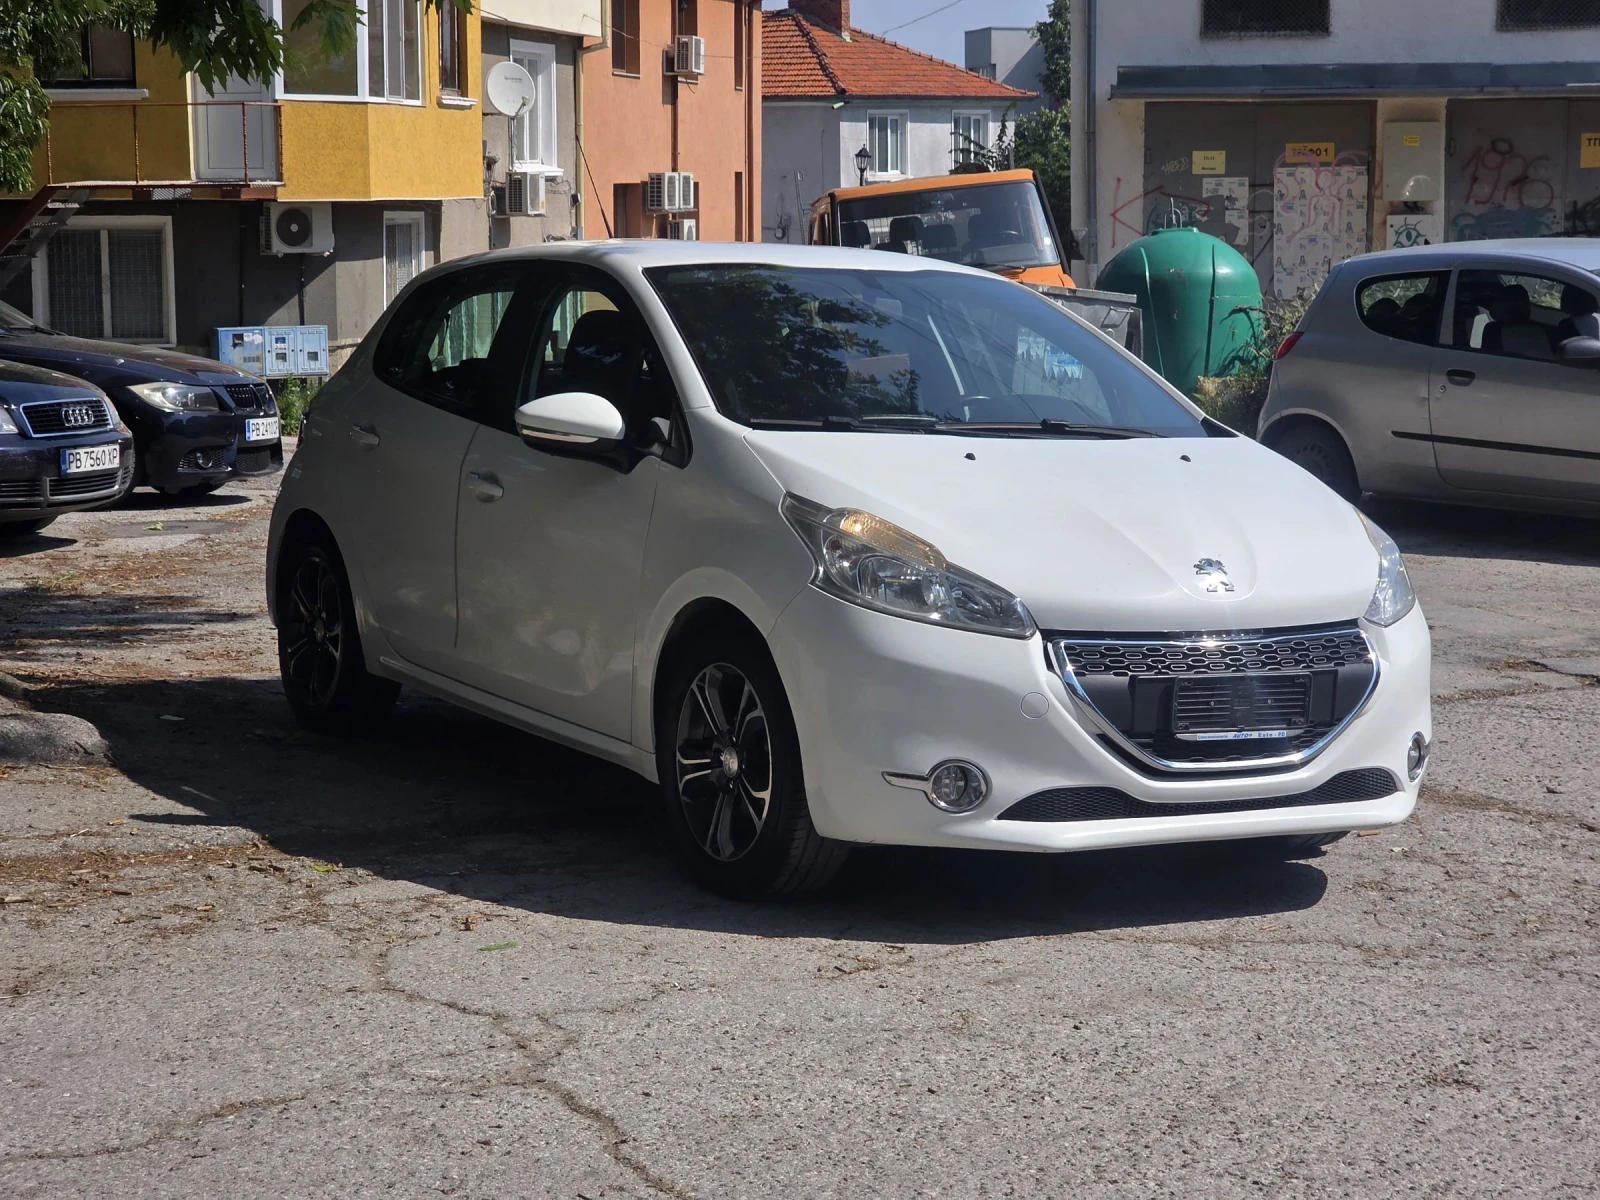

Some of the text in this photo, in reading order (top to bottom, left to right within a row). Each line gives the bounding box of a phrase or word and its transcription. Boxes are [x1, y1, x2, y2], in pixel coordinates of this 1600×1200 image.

[68, 447, 118, 470] PB 7560 XP
